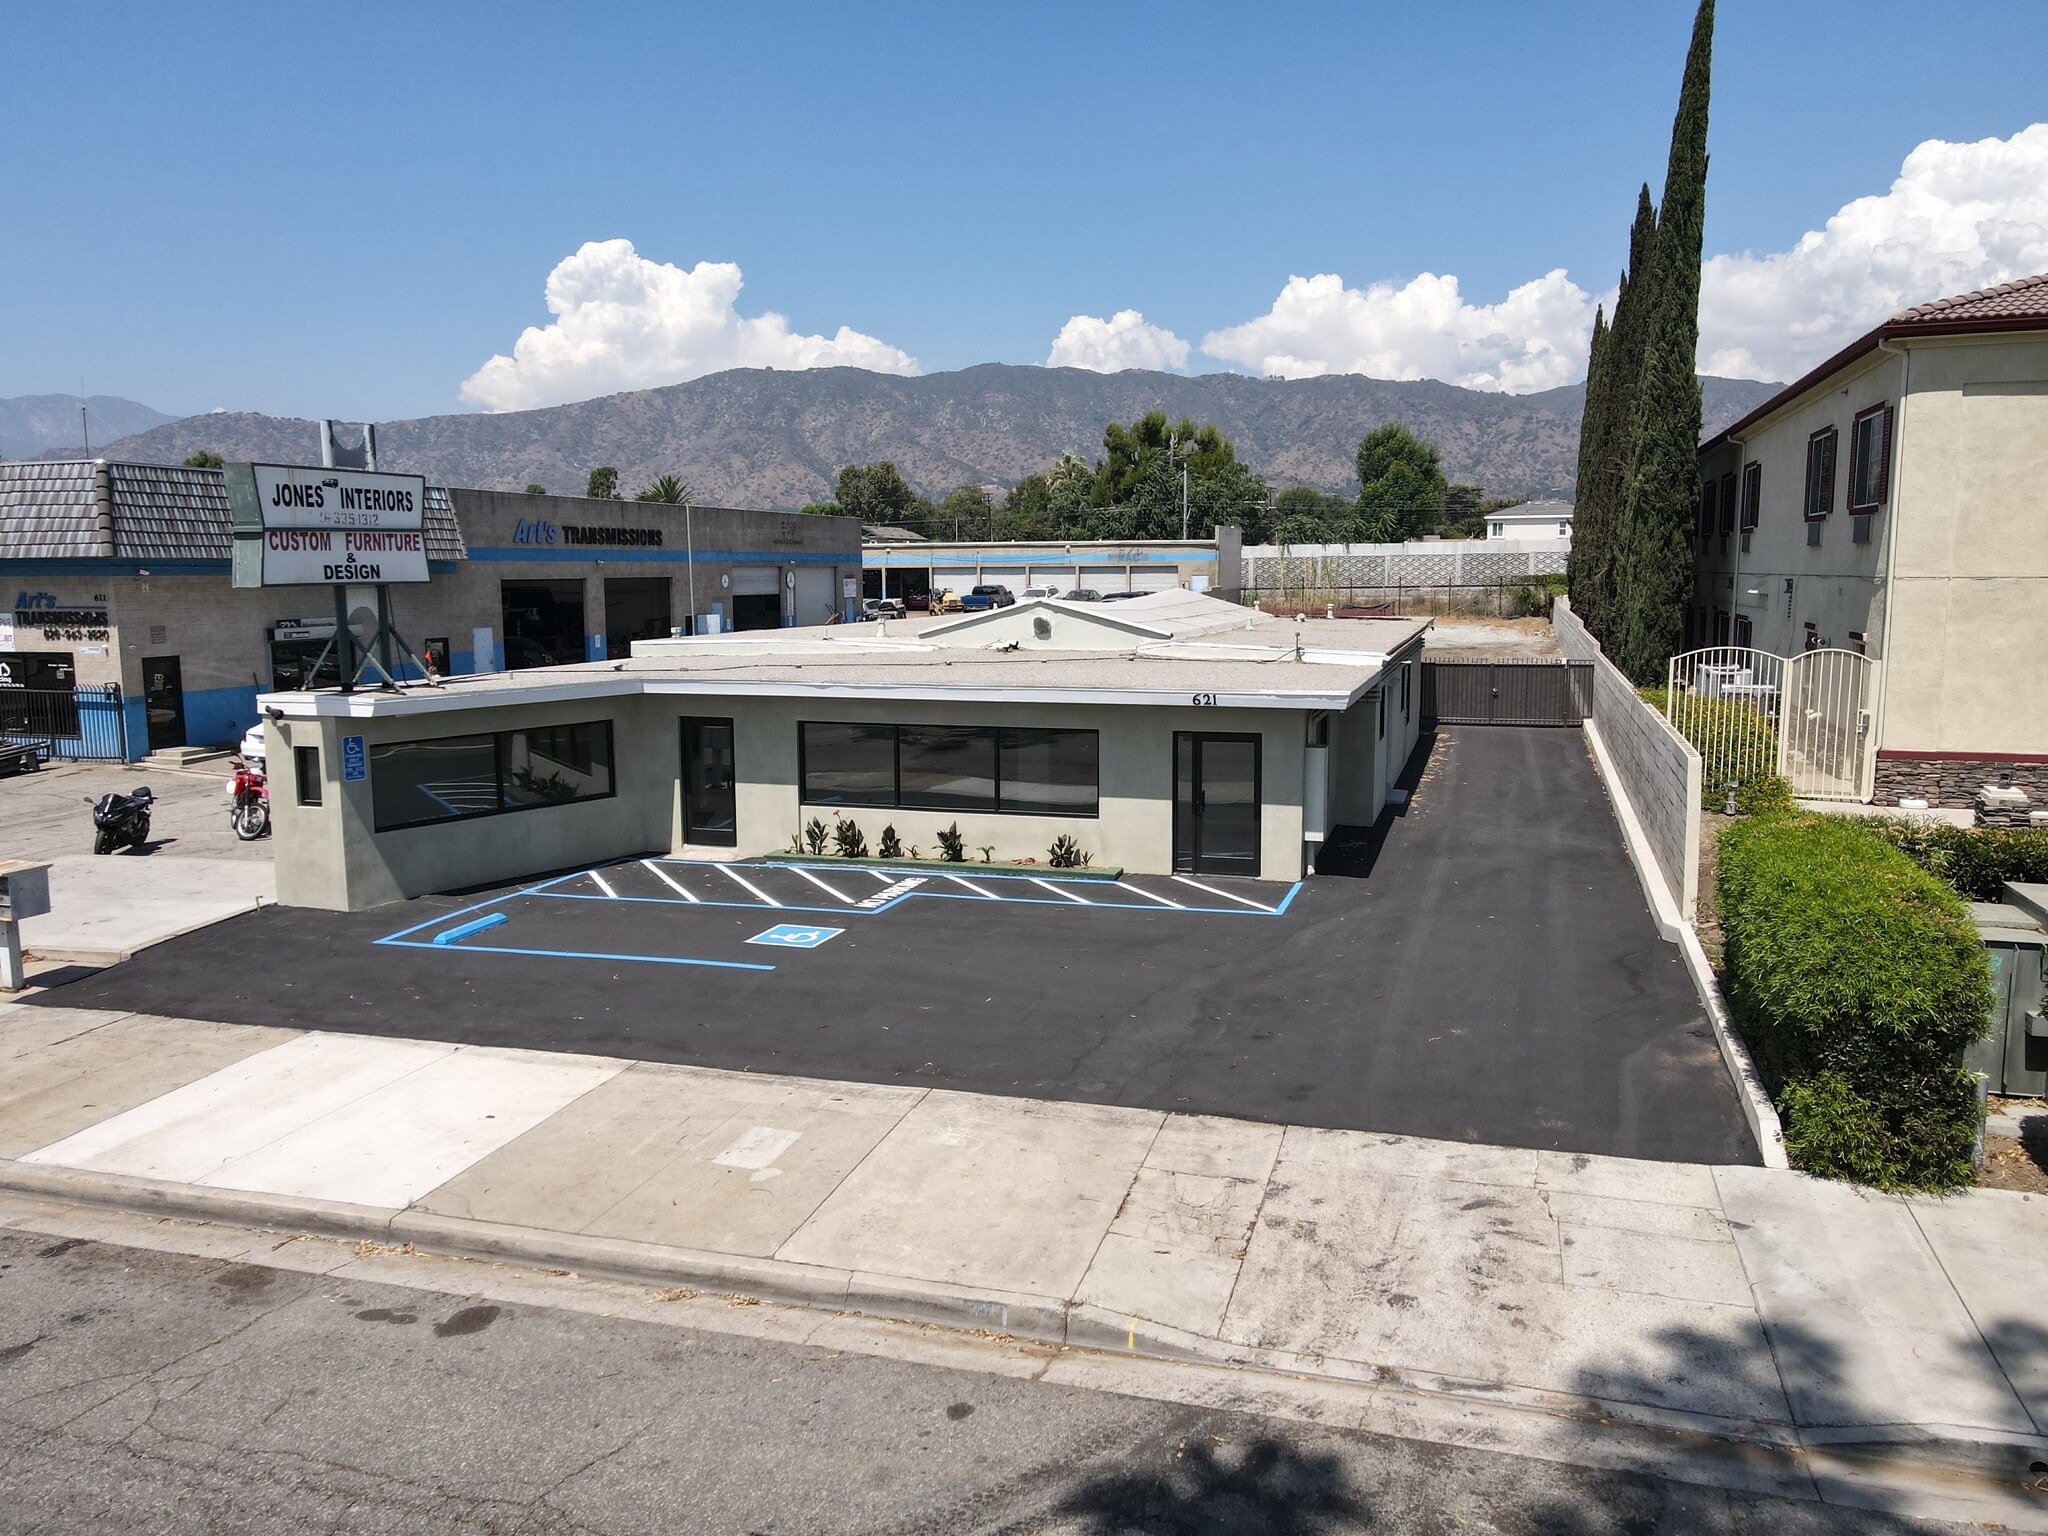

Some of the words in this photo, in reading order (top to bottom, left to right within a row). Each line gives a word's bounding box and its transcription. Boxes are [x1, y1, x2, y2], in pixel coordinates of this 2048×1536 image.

[272, 484, 324, 508] JONES
[340, 487, 414, 512] INTERIORS
[513, 518, 558, 544] Art's
[562, 525, 663, 546] TRANSMISSIONS
[269, 531, 331, 551] CUSTOM
[345, 532, 421, 552] FURNITURE
[346, 552, 356, 563] &
[324, 564, 381, 580] DESIGN
[15, 591, 57, 609] Art's
[94, 593, 107, 602] 611
[15, 611, 109, 628] TRANSMISSIONS
[1192, 693, 1217, 706] 621
[853, 898, 887, 909] NO
[870, 877, 929, 901] PARKING
